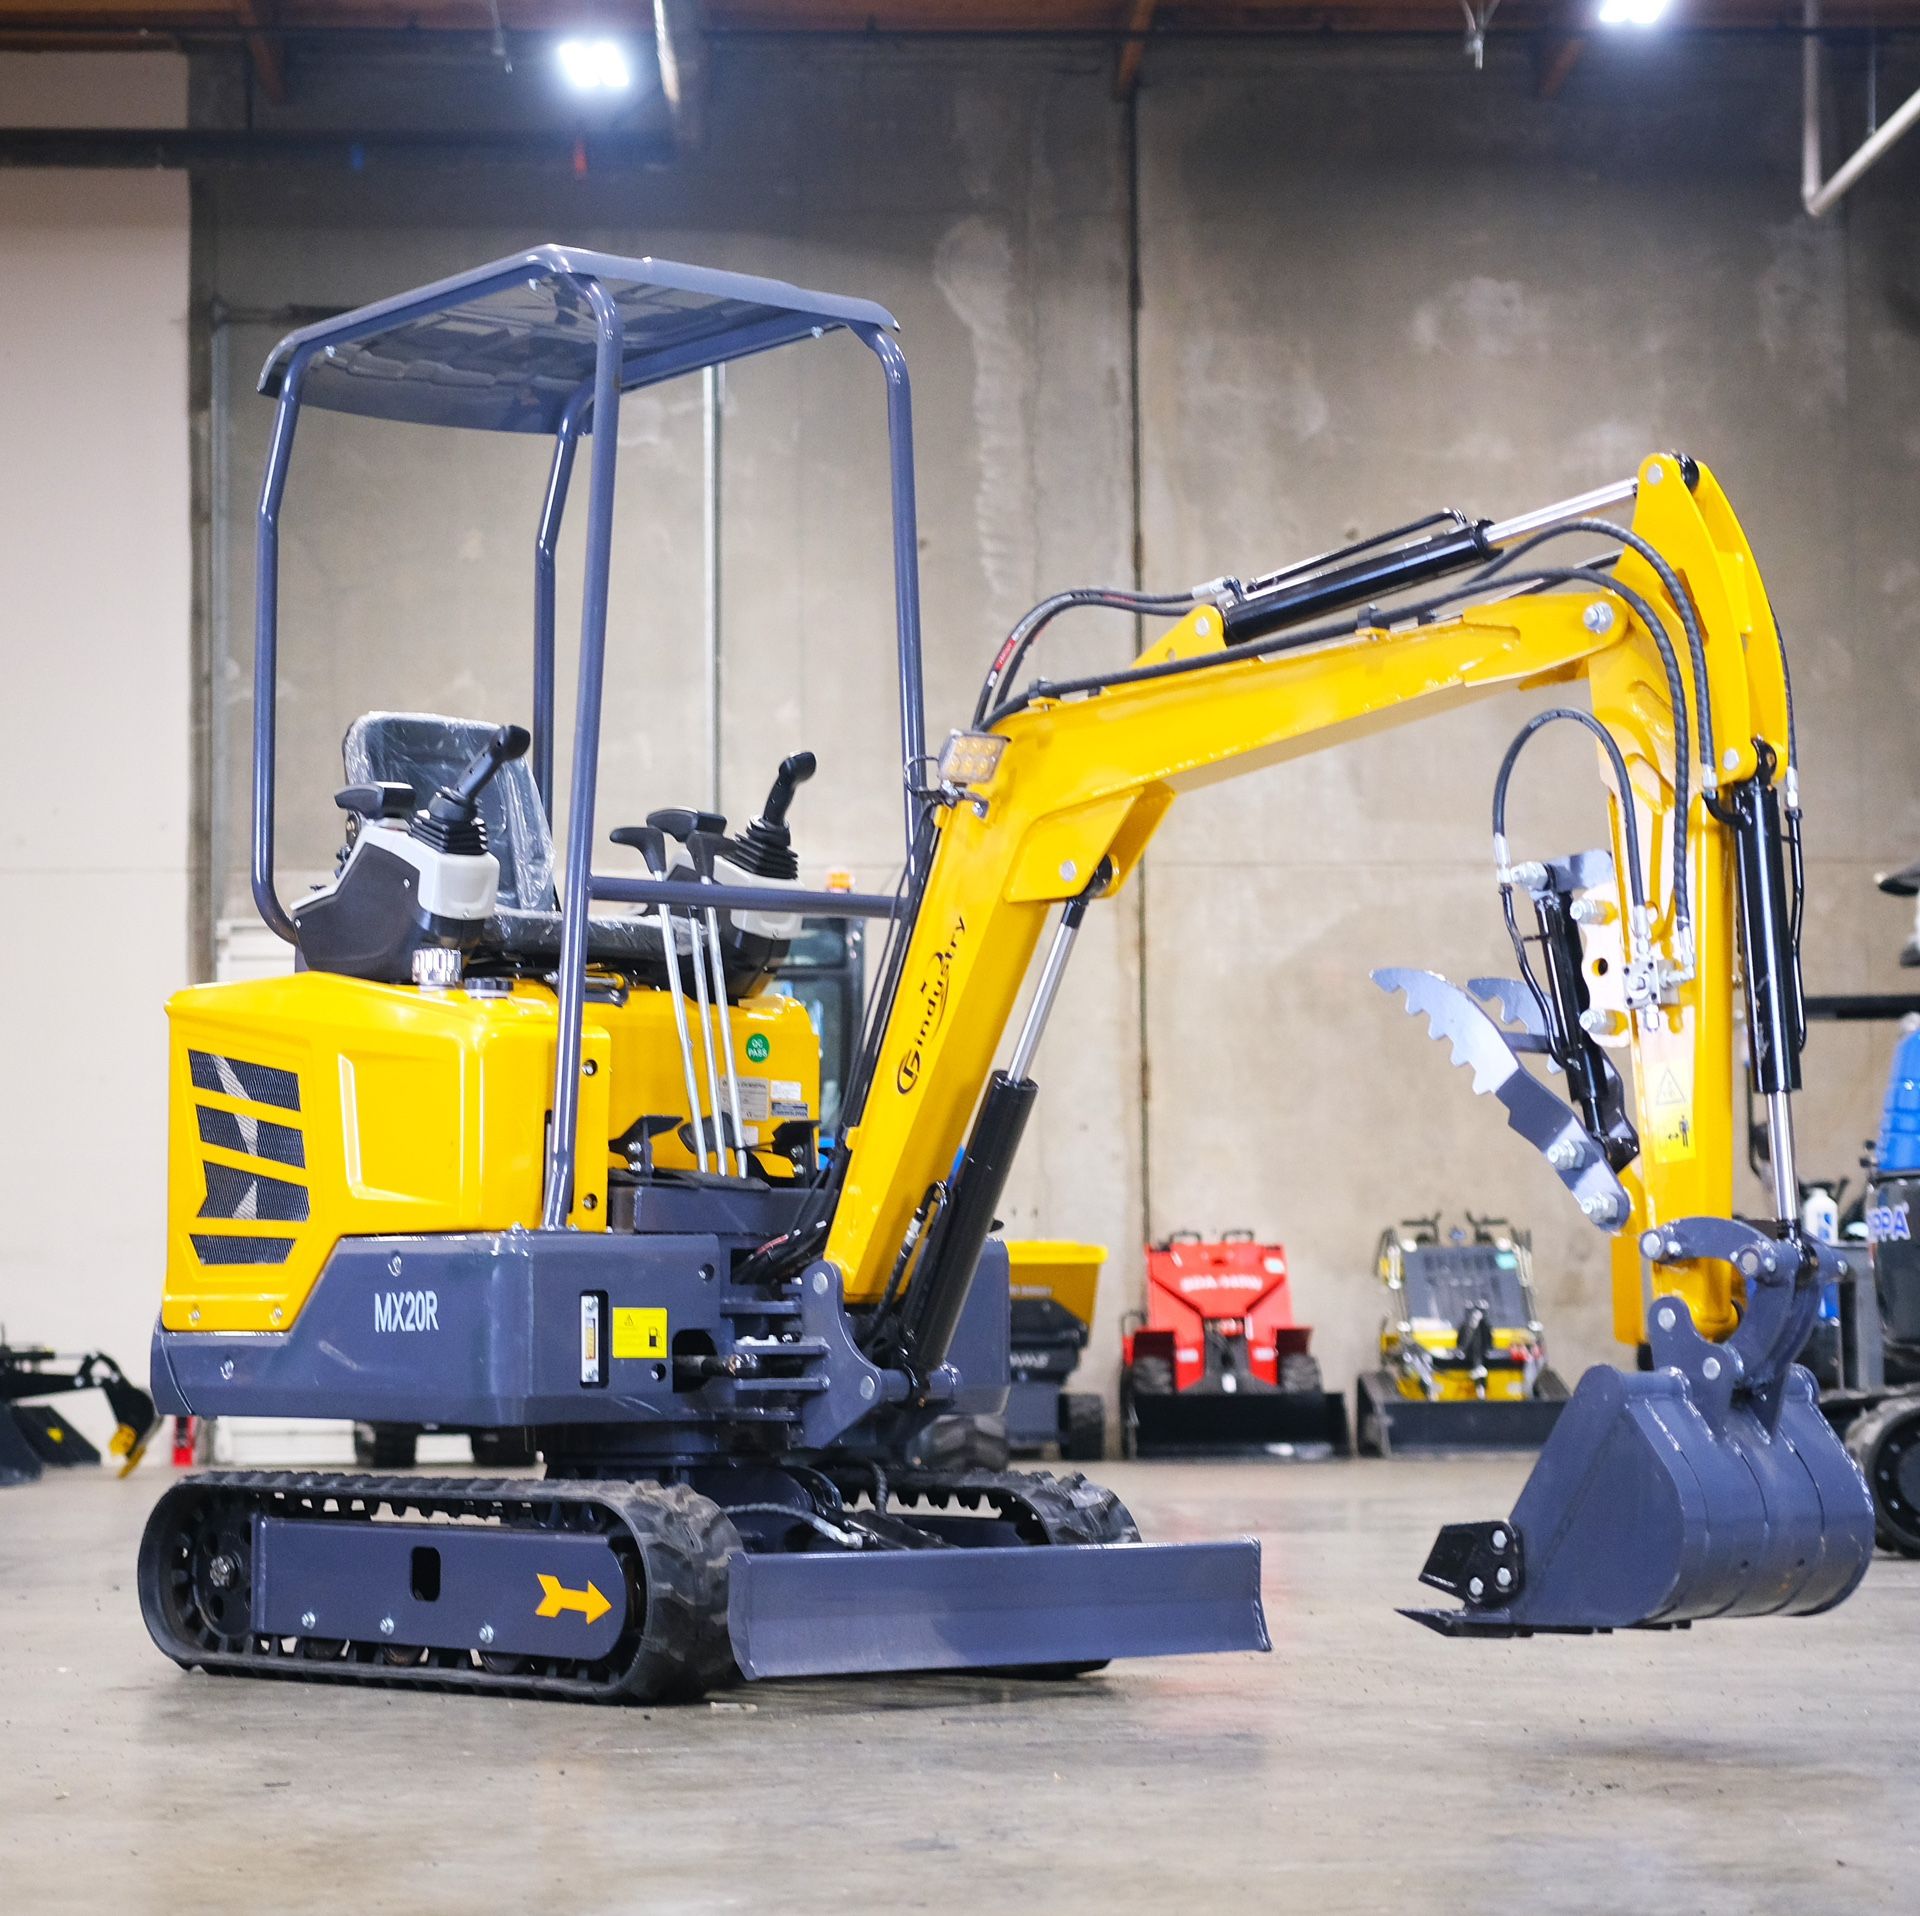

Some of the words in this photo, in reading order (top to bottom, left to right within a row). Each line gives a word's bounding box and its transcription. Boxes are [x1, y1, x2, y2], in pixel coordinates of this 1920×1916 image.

[751, 1038, 763, 1048] QC
[748, 1048, 768, 1058] PASS
[374, 1290, 439, 1333] MX20R
